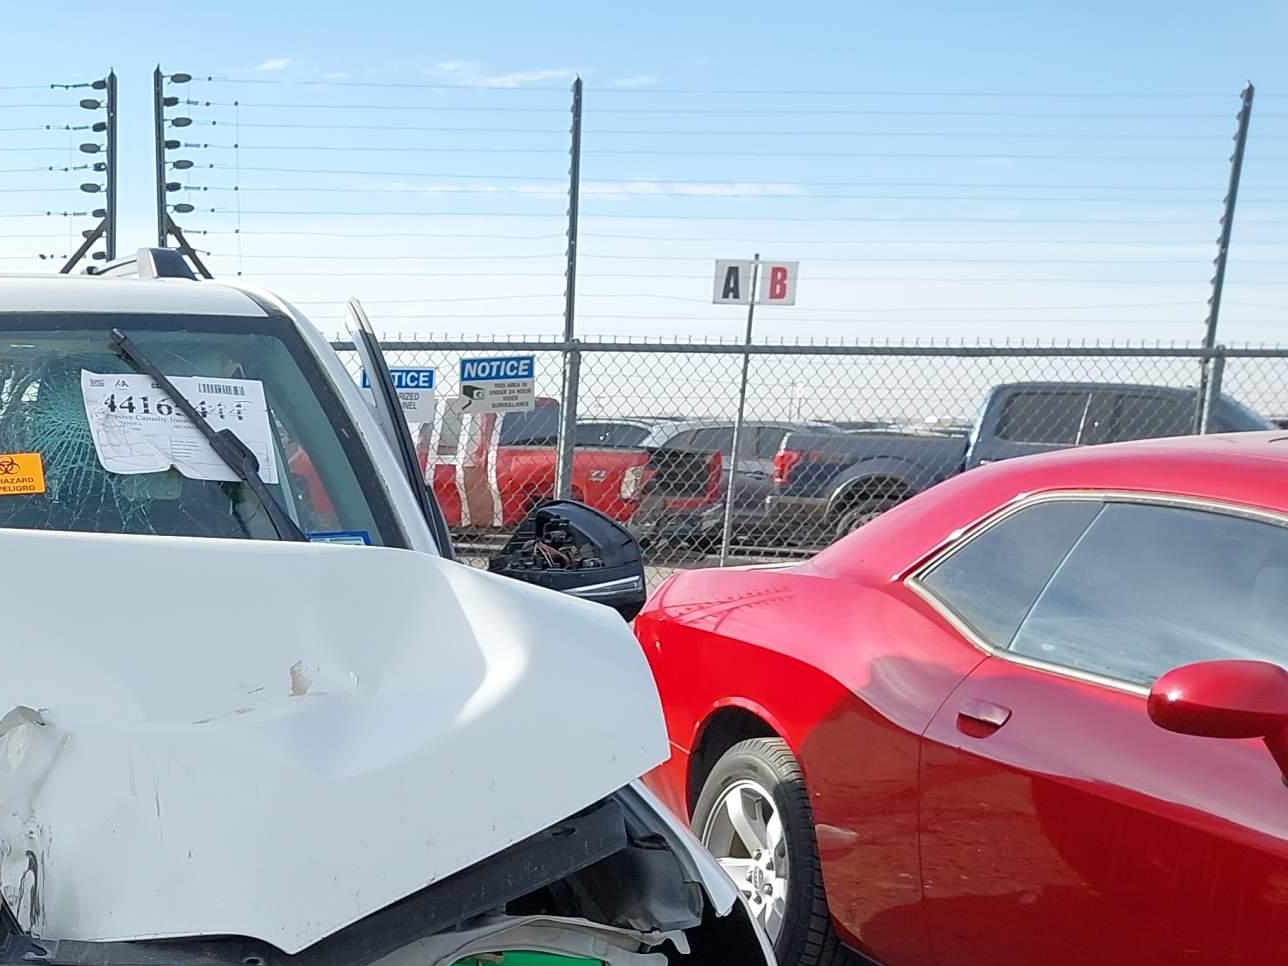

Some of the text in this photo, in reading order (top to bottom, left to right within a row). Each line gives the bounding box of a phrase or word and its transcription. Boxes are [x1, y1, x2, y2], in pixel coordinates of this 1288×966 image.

[721, 266, 740, 299] A
[768, 266, 788, 299] B
[365, 372, 430, 387] TICE
[463, 359, 531, 378] NOTICE
[104, 393, 248, 421] 4416444
